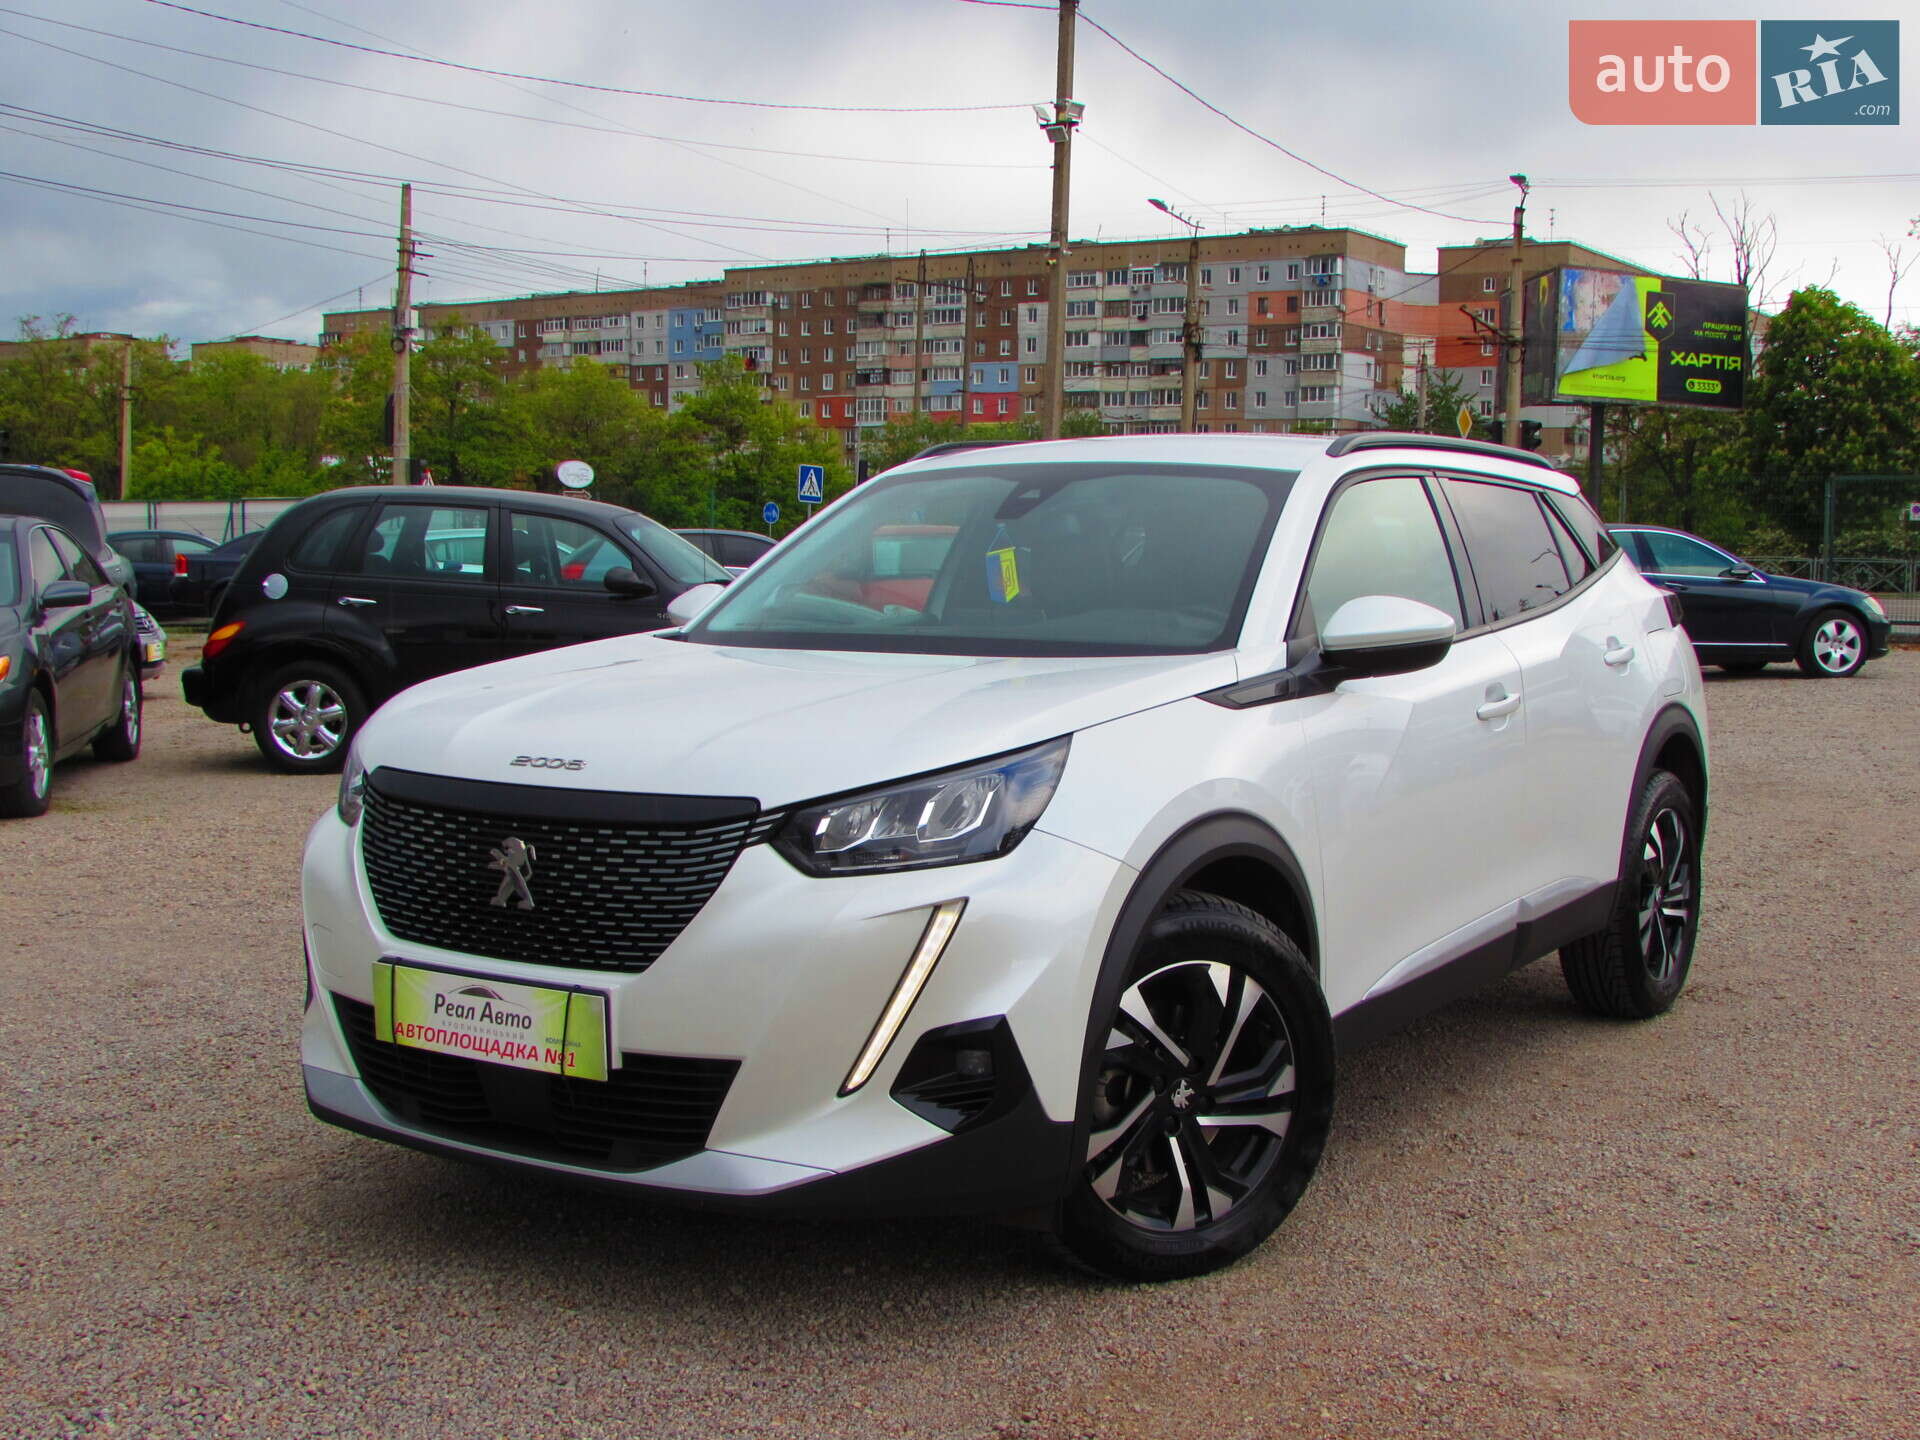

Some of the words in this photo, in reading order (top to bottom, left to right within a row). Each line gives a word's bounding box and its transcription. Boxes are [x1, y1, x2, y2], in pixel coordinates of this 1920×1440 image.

[1670, 351, 1742, 371] ХАРТІЯ
[433, 992, 475, 1021] Реал
[480, 1001, 533, 1030] Авто
[394, 1021, 539, 1061] АВТОПЛОЩАДКА
